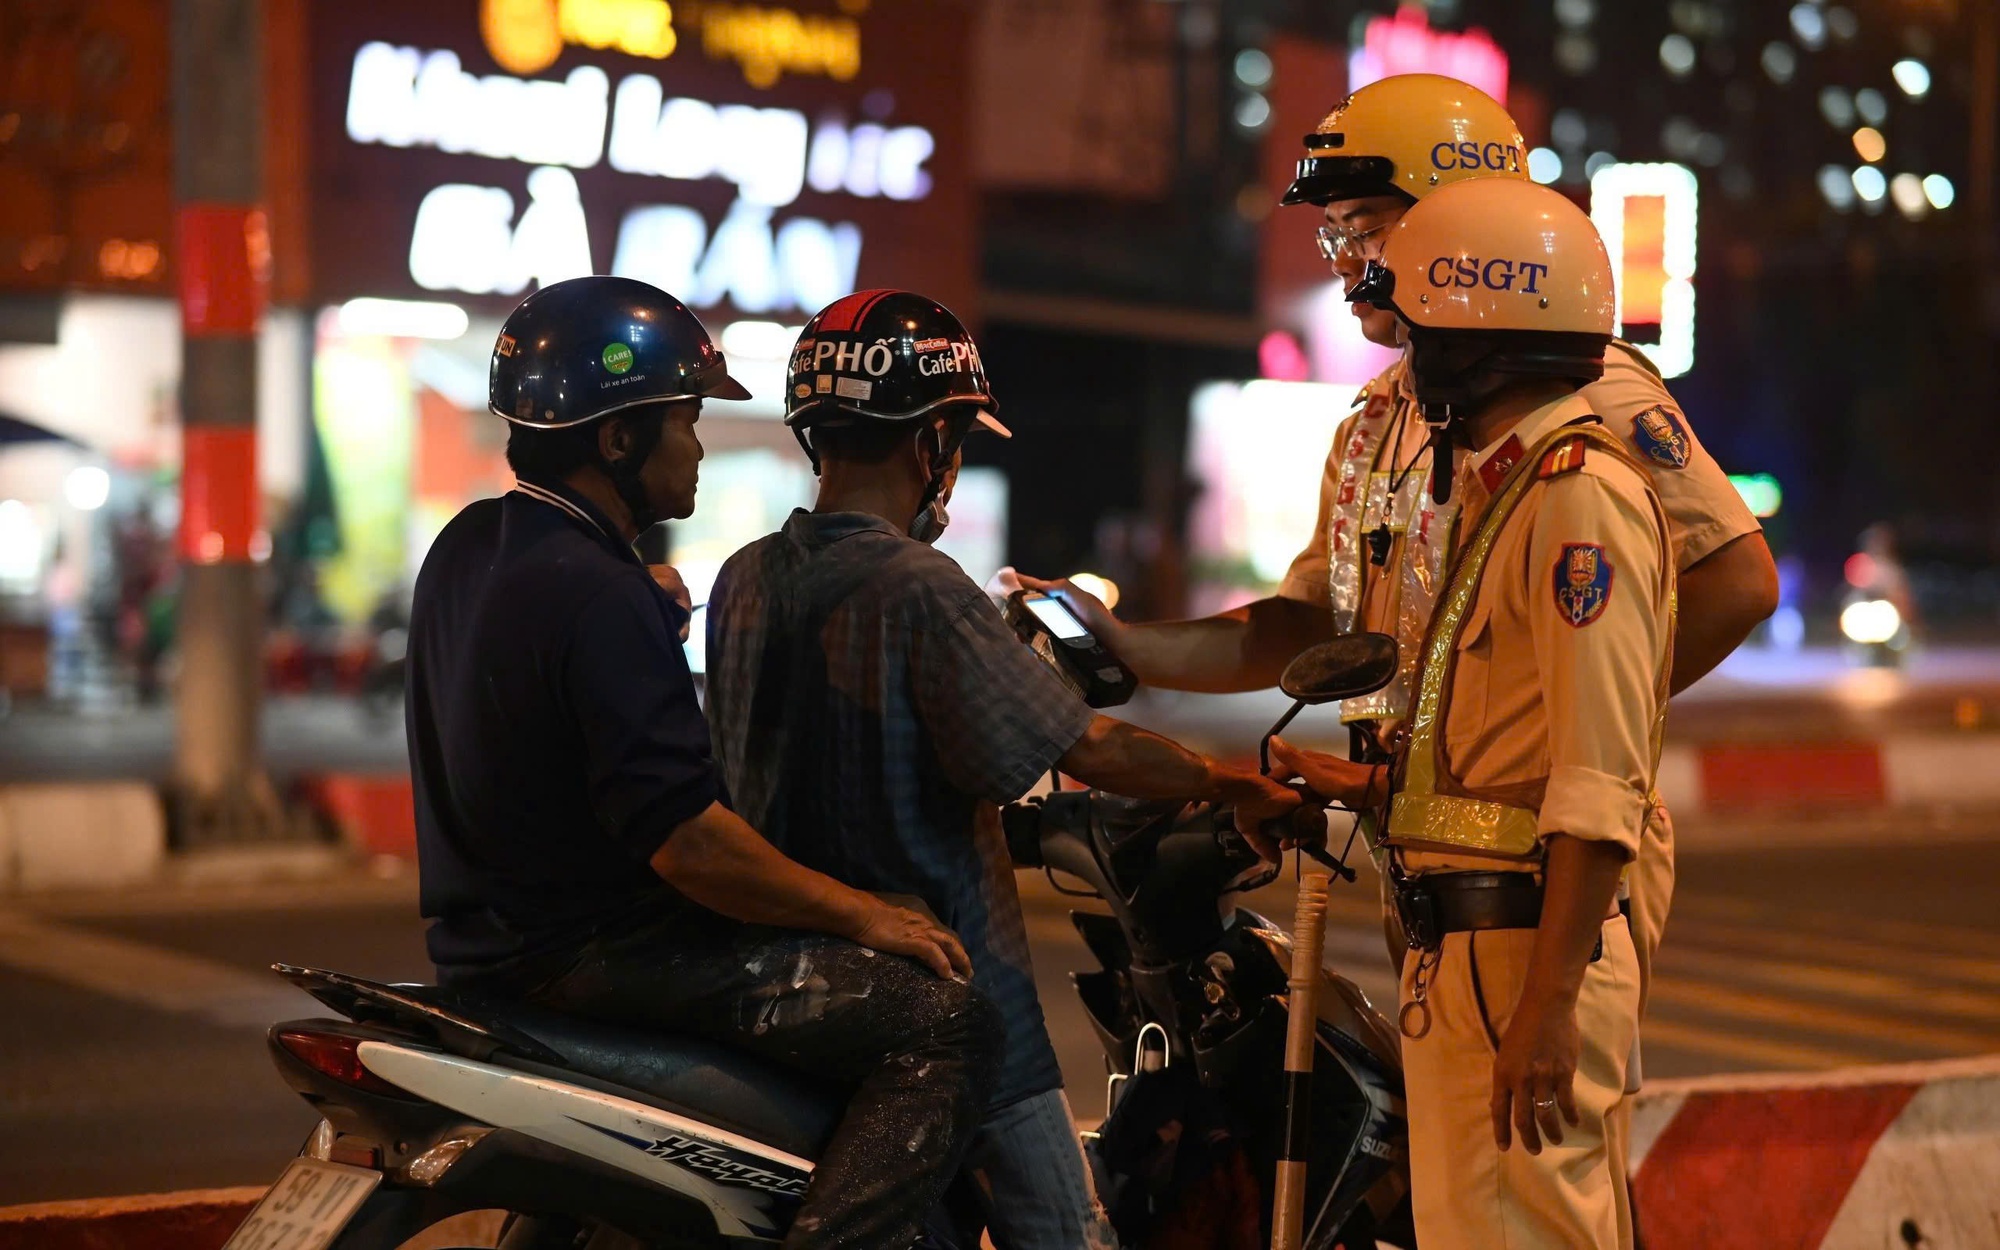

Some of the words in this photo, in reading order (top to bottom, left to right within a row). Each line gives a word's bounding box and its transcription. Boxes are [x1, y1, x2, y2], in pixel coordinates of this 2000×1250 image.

[1431, 142, 1520, 173] CSGT
[1428, 257, 1548, 294] CSGT
[793, 351, 813, 375] afé
[813, 337, 897, 376] PHỐ
[918, 351, 954, 376] Café
[951, 342, 979, 373] PH
[1651, 432, 1685, 456] CSGT
[1558, 586, 1603, 601] CSGT
[1360, 1135, 1393, 1160] SUZ
